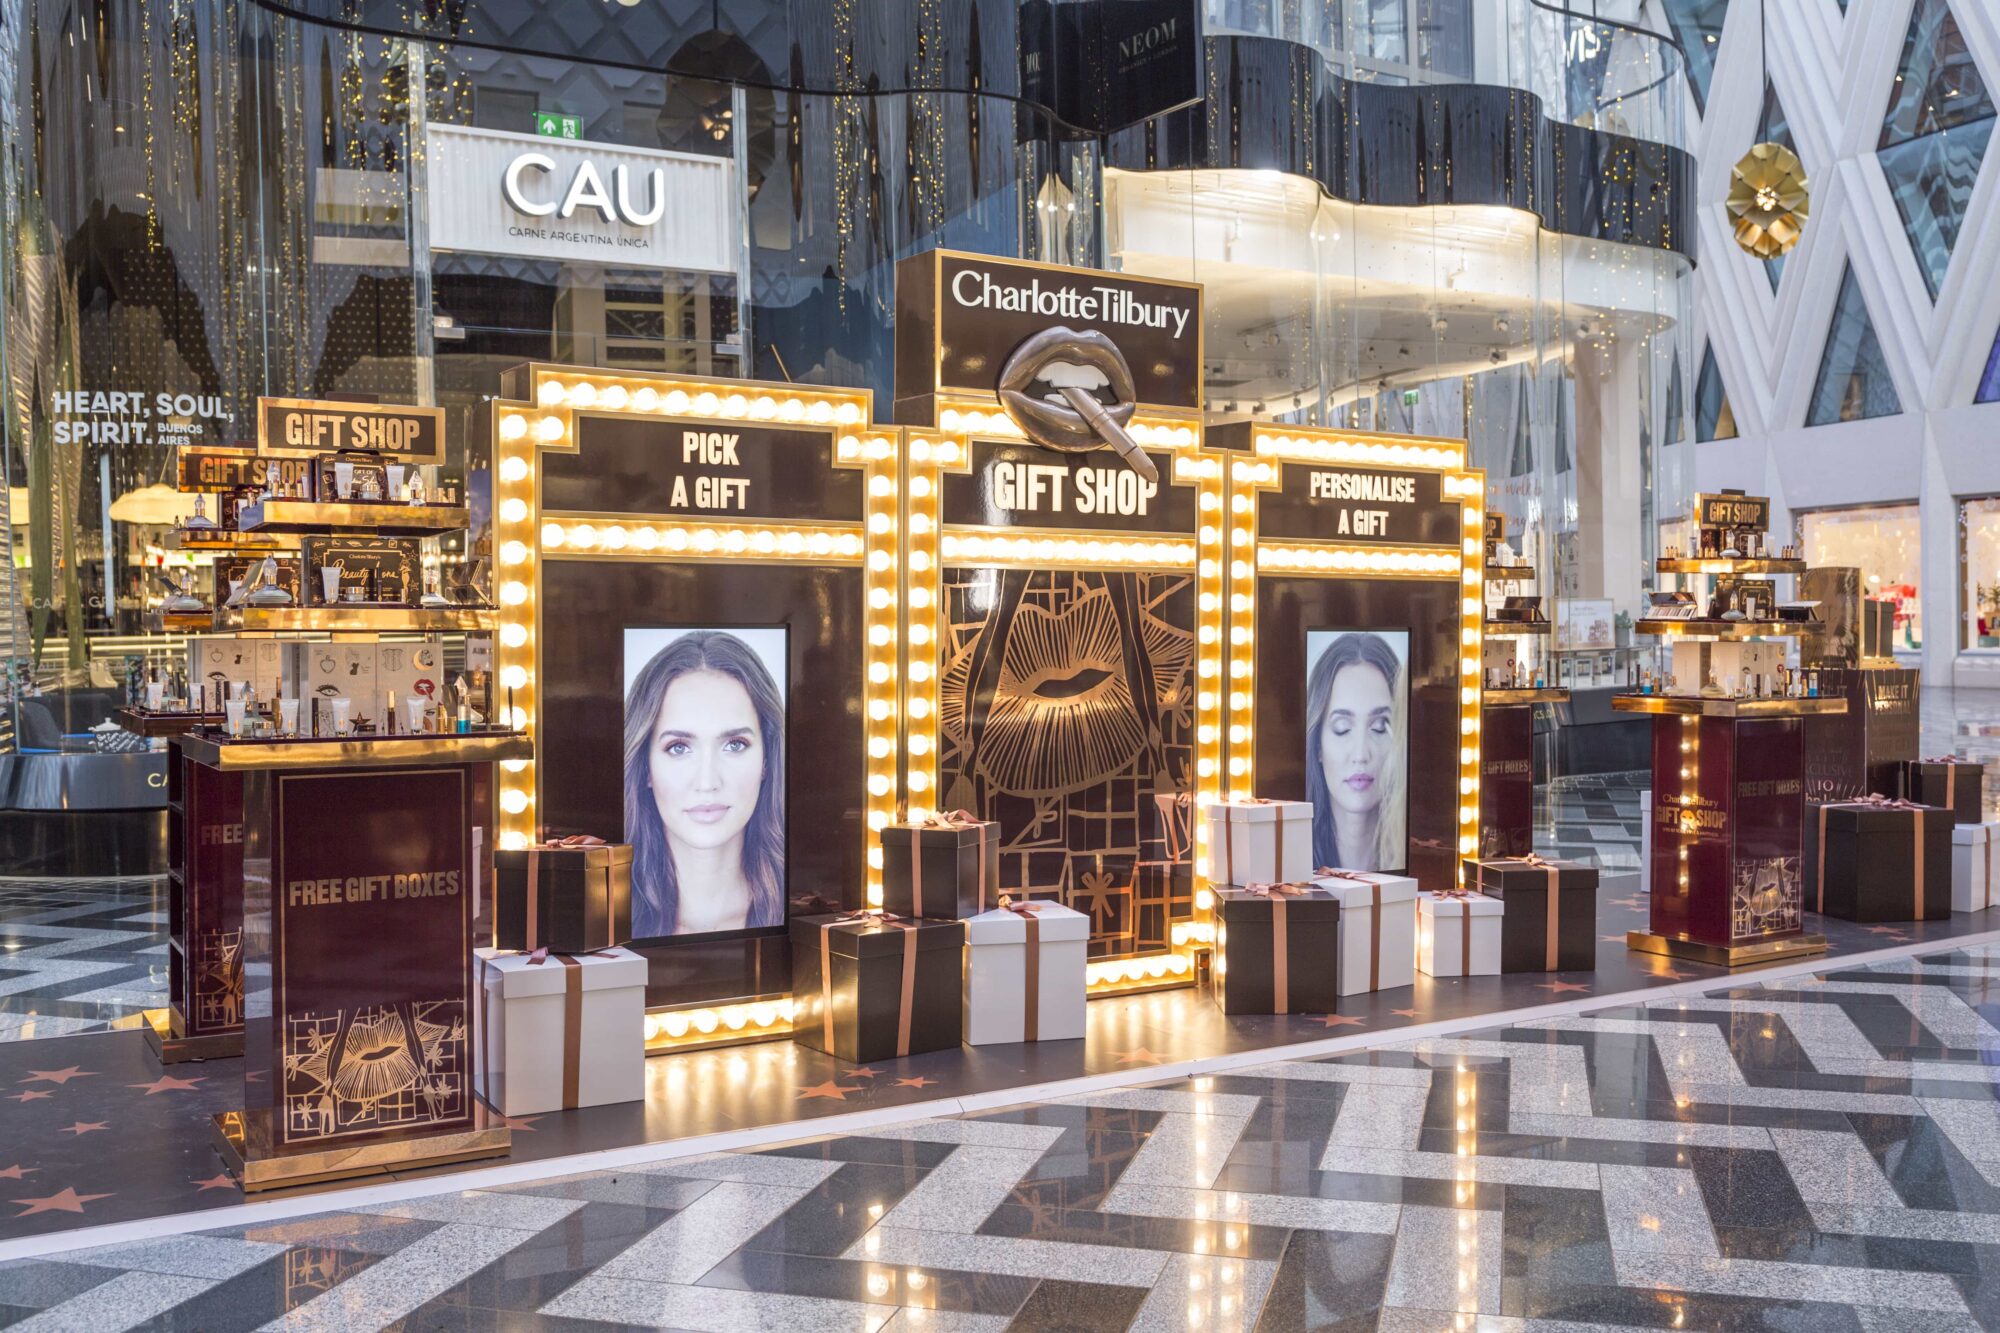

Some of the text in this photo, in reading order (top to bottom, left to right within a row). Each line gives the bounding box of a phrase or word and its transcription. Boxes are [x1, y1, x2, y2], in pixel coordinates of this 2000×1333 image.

[1118, 17, 1177, 62] NEOM
[503, 152, 665, 226] CAU
[508, 226, 649, 249] CARNE ARGENTINA ÚNICA
[54, 391, 235, 423] HEART, SOUL,
[54, 421, 153, 444] SPIRIT.
[157, 422, 203, 434] BUENOS
[157, 435, 191, 446] AIRES
[285, 412, 420, 450] GIFT SHOP
[682, 431, 740, 466] PICK
[200, 457, 249, 484] GIFT
[670, 475, 751, 510] A GIFT
[994, 461, 1158, 516] GIFT SHOP
[1310, 471, 1416, 503] PERSONALISE
[1337, 508, 1389, 537] A GIFT
[1709, 501, 1761, 524] GIFT SHOP
[1655, 805, 1728, 829] GIFT SHOP
[201, 823, 243, 845] FREE
[289, 878, 343, 907] FREE
[345, 875, 391, 902] GIFT
